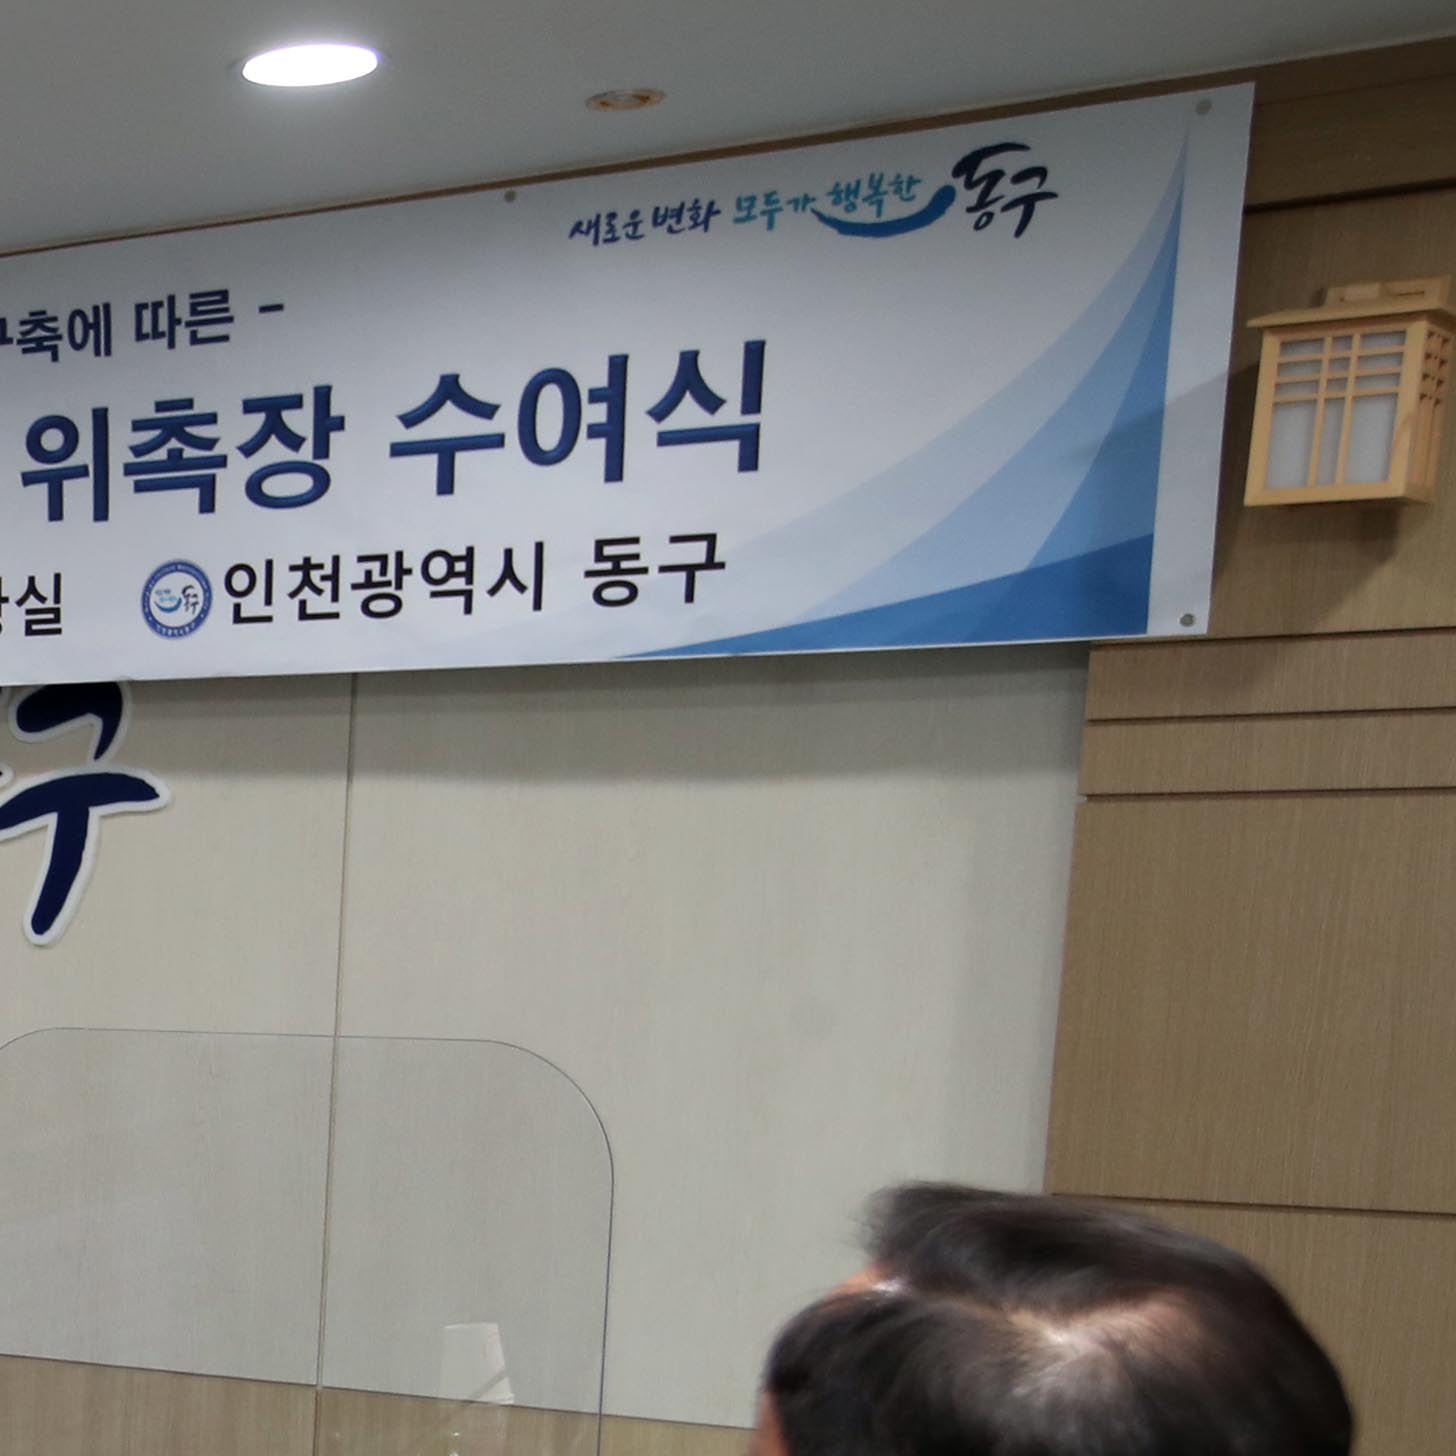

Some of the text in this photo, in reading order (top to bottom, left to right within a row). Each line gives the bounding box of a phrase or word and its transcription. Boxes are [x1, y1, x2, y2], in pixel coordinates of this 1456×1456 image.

[569, 141, 1059, 246] 새로운 변화 모두가 행복한 동구
[134, 288, 235, 351] 따른
[20, 384, 346, 524] 위촉장
[389, 338, 767, 497] 수여식
[223, 540, 546, 626] 인천광역시
[583, 531, 727, 608] 동구
